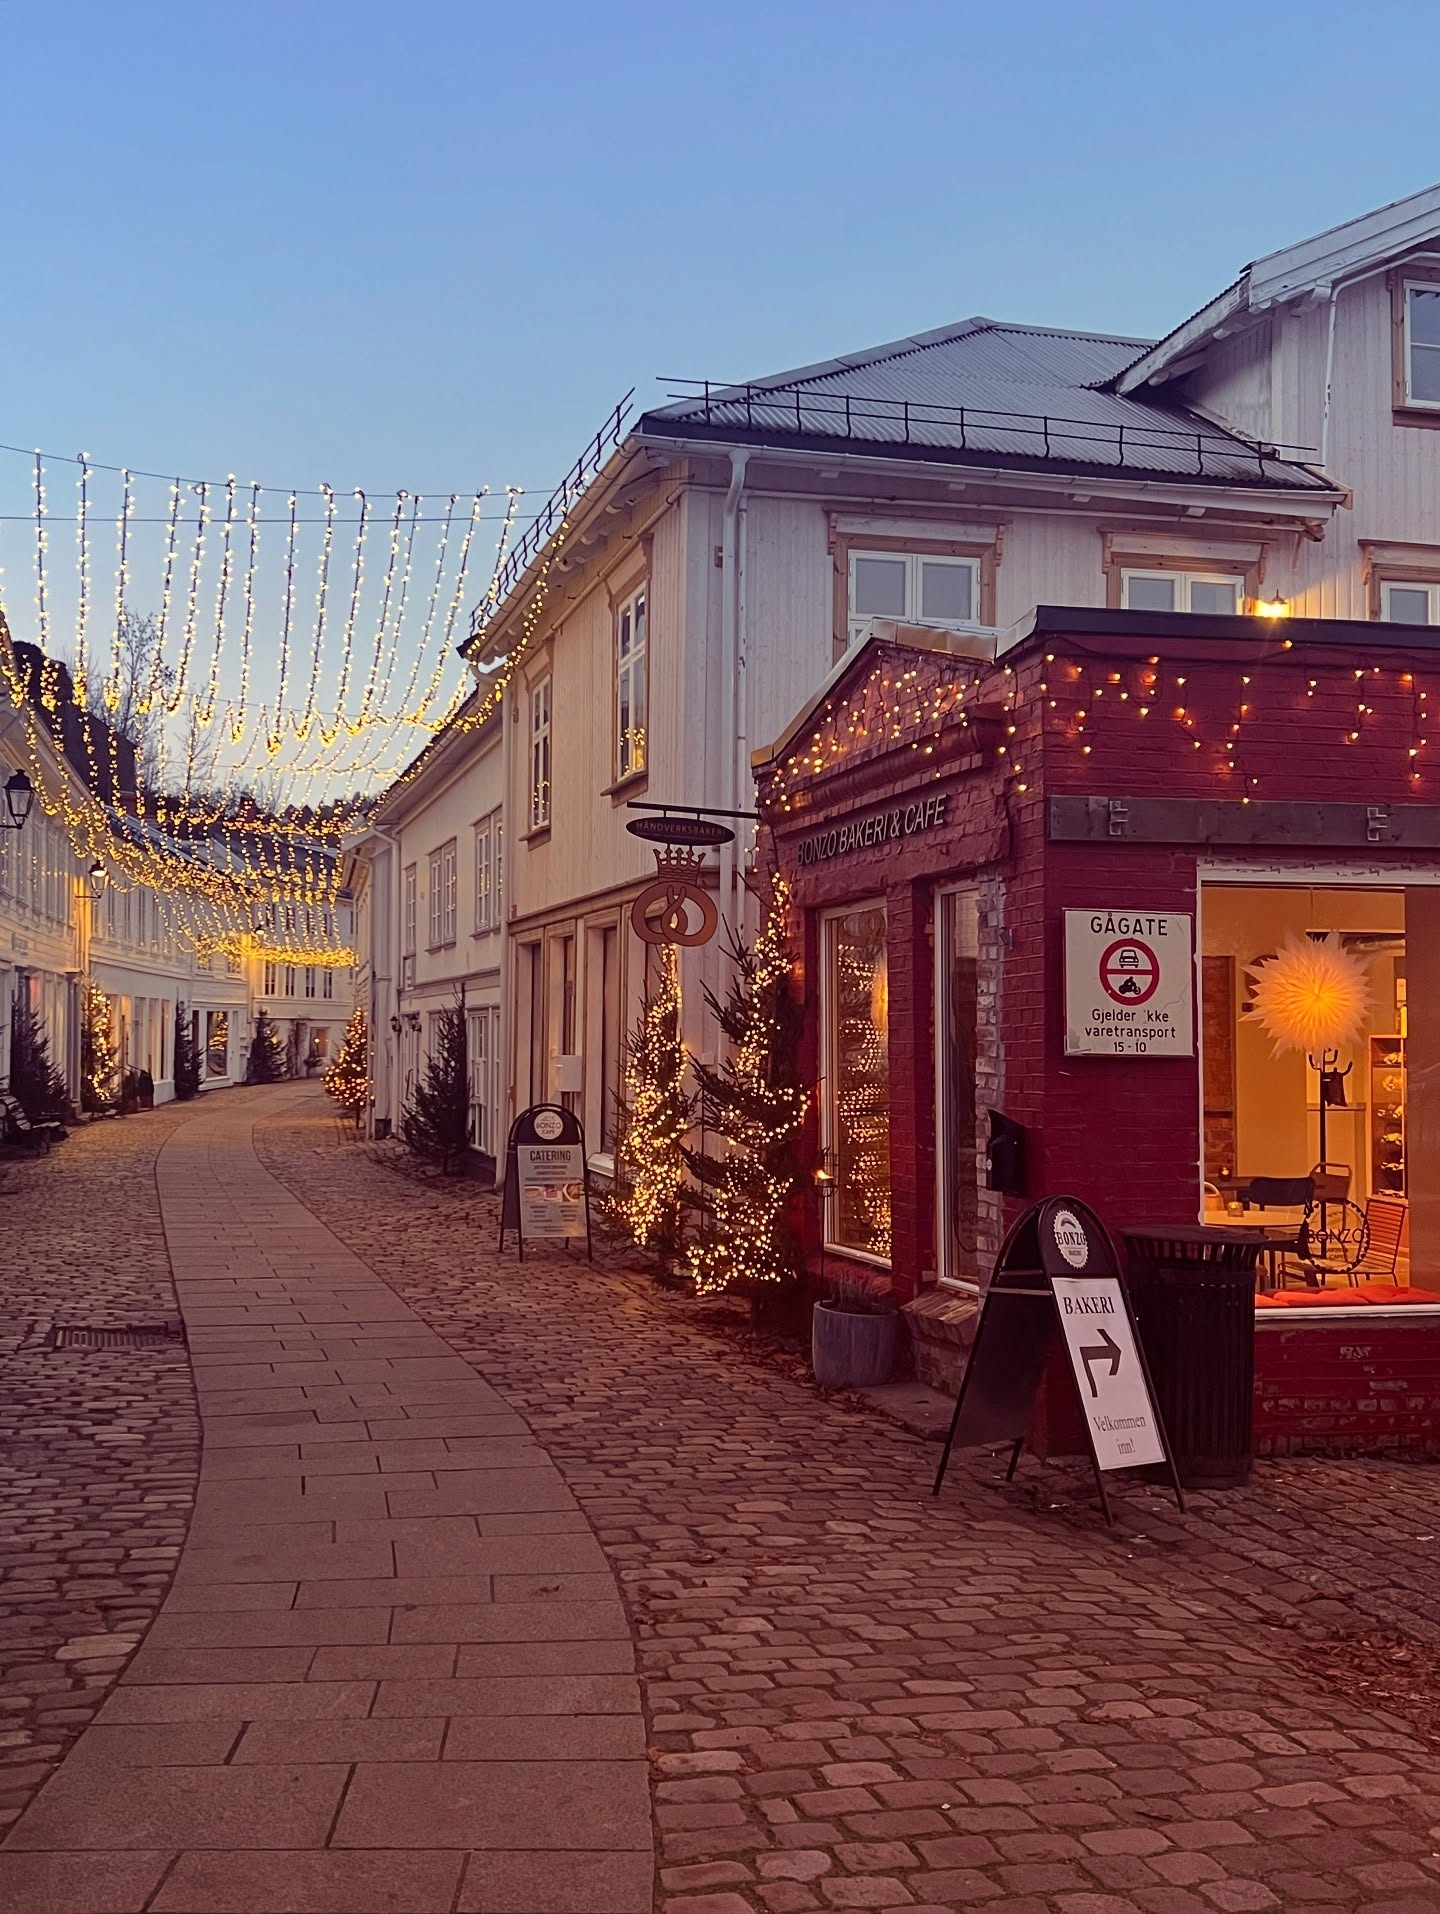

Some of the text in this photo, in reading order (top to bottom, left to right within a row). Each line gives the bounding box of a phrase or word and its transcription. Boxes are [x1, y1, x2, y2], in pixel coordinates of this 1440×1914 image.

[797, 793, 947, 865] BONZO BAKERI & CAFE
[1090, 911, 1168, 936] GÅGATE
[1092, 1008, 1169, 1023] Gjelder kke
[1085, 1025, 1176, 1040] varetransport
[1113, 1041, 1125, 1053] 15
[1135, 1041, 1147, 1053] 10
[530, 1150, 571, 1161] CATERING
[1056, 1231, 1087, 1246] BONZO
[1307, 1228, 1363, 1244] BONZO
[1063, 1296, 1116, 1315] BAKERI
[1093, 1415, 1147, 1432] Velkommen
[1116, 1437, 1136, 1455] inn!
